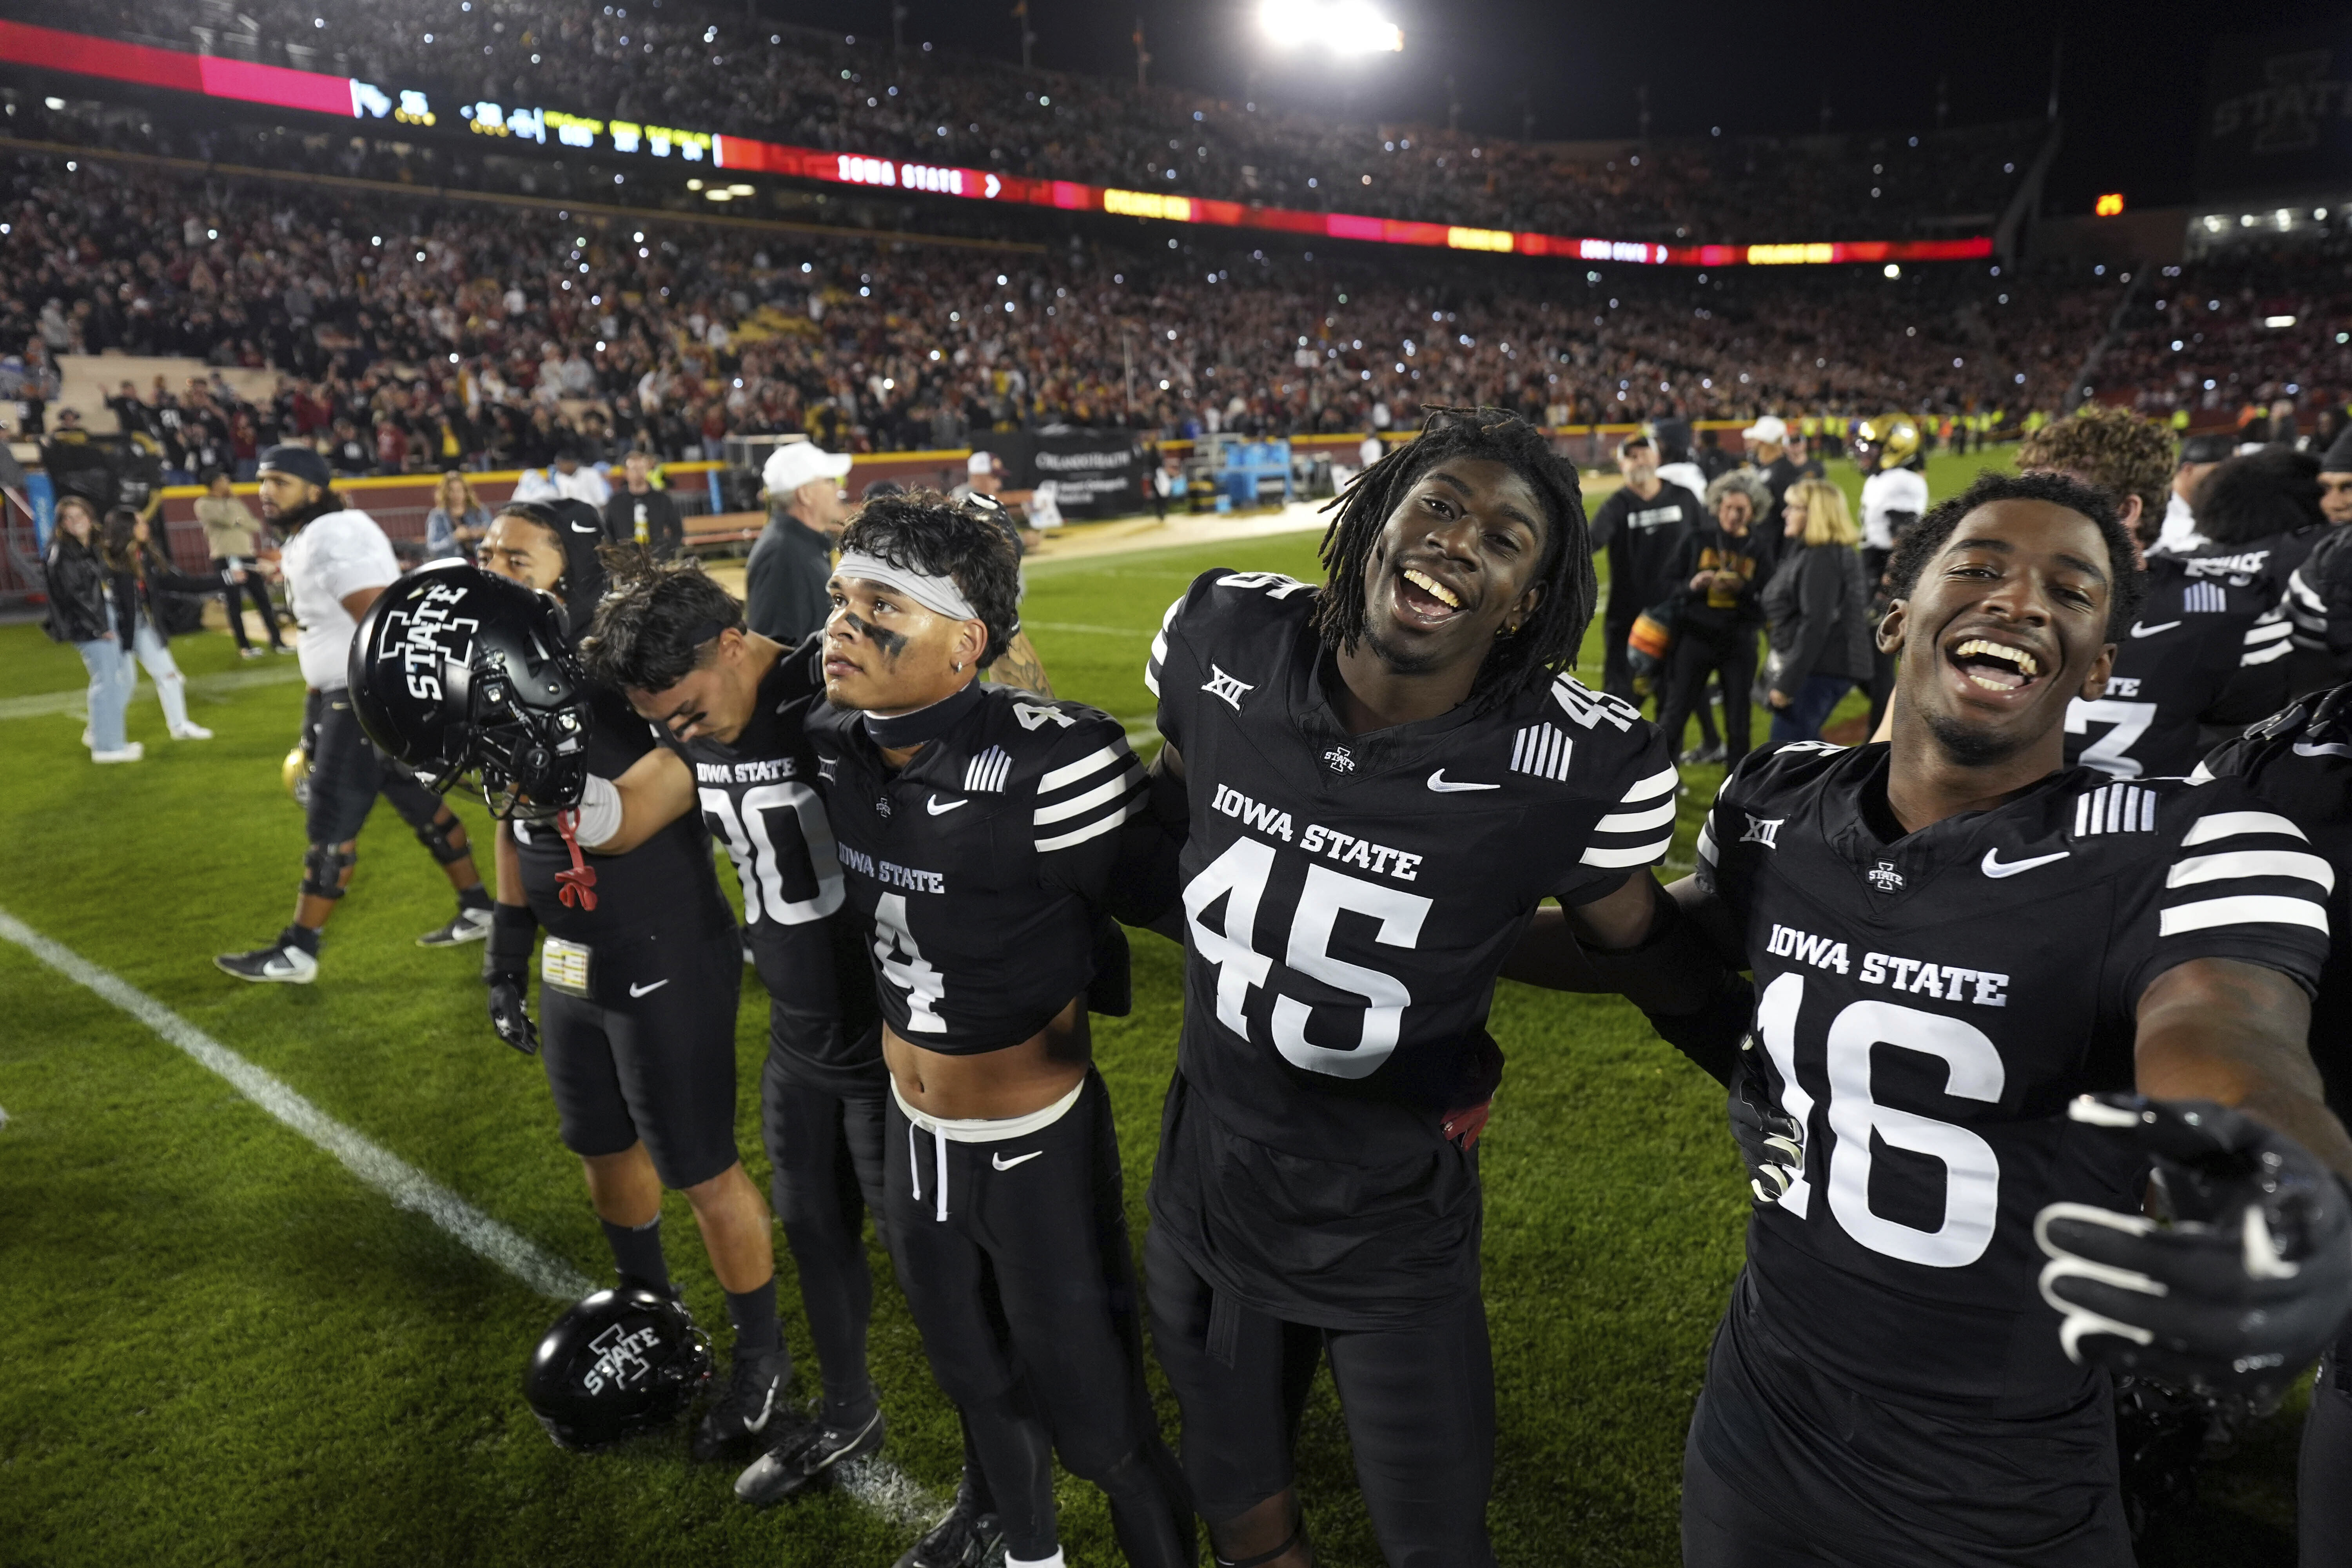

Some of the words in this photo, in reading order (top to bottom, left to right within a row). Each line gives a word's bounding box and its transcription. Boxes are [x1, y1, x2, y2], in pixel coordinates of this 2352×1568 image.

[837, 155, 896, 186] IOWA
[902, 164, 963, 194] STATE
[405, 584, 468, 701] STATE
[1012, 702, 1077, 731] 4
[1201, 664, 1254, 711] XII
[1551, 672, 1641, 732] 45
[696, 763, 733, 783] IOWA
[734, 757, 797, 783] STATE
[1324, 751, 1355, 771] STATE
[1211, 783, 1293, 842] IOWA
[1300, 824, 1423, 881] STATE
[838, 841, 875, 878] IOWA
[878, 860, 945, 894] STATE
[874, 891, 947, 1033] 4
[1182, 836, 1434, 1079] 45
[1766, 924, 1850, 975] IOWA
[1859, 952, 2010, 1007] STATE
[1758, 972, 2005, 1268] 16
[583, 1327, 661, 1396] STATE
